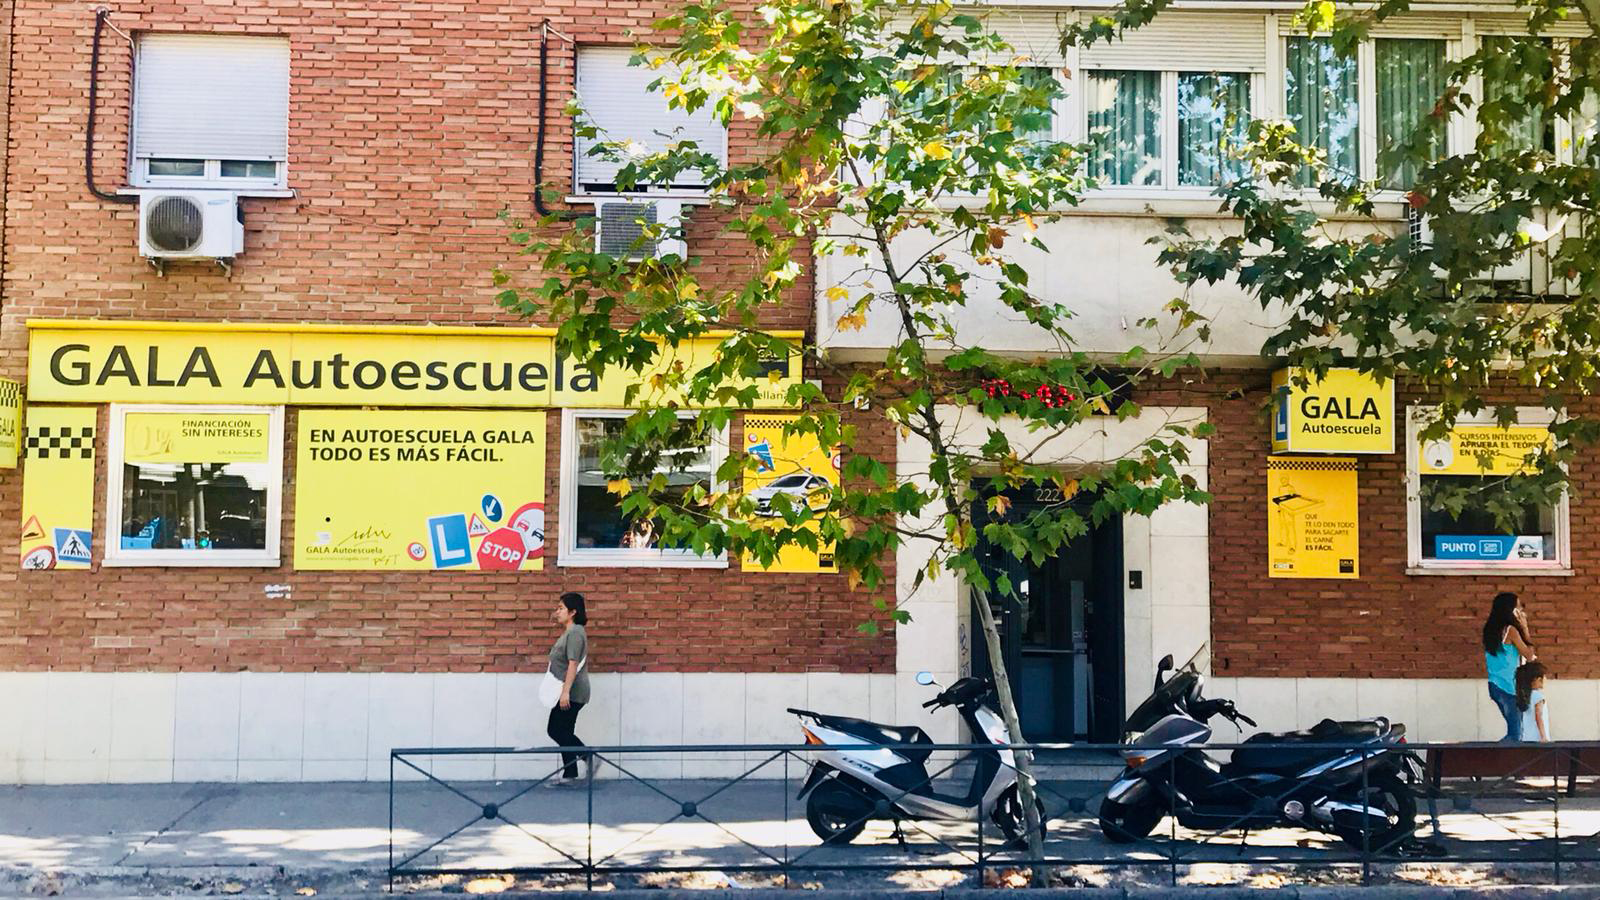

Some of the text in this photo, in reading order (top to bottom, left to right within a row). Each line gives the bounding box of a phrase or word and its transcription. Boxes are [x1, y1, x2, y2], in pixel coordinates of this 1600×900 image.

[50, 344, 599, 392] GALA Autoescuela
[1301, 396, 1381, 420] GALA
[182, 419, 252, 428] FINANCIACIÓN
[1302, 423, 1382, 435] Autoescuela
[182, 429, 263, 437] SIN INTERESES
[310, 429, 534, 444] EN AUTOESCUELA GALA
[310, 444, 504, 462] TODO ES MÁS FÁCIL.
[1460, 449, 1470, 457] EN
[1036, 488, 1060, 502] 222
[436, 524, 466, 561] L
[1442, 543, 1476, 552] PUNTO
[306, 546, 383, 554] GALA Autoescuela
[481, 541, 522, 563] STOP
